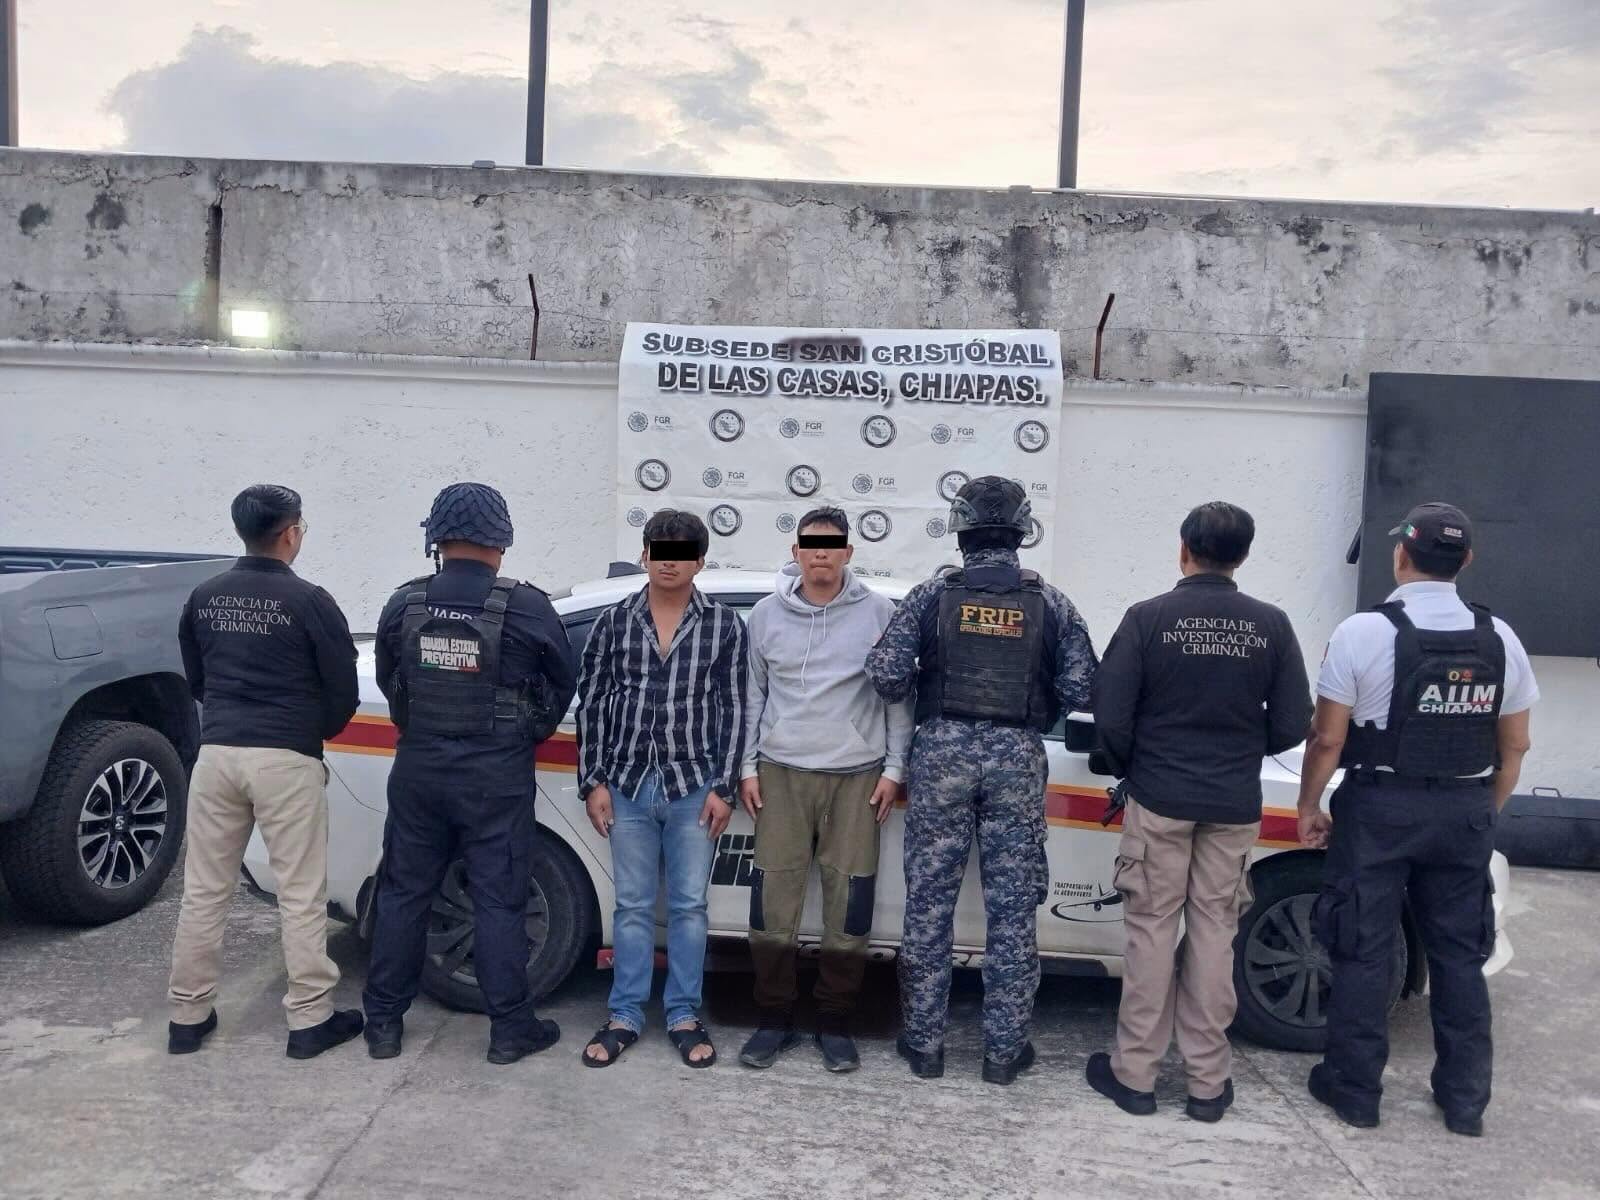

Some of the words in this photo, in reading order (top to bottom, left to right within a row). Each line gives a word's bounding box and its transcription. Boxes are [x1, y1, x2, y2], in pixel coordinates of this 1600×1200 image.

[642, 332, 789, 361] SUBSEDE
[798, 342, 864, 362] SAN
[871, 338, 1051, 364] CRISTÓBAL
[658, 361, 699, 390] DE
[707, 364, 768, 393] LAS
[777, 367, 889, 403] CASAS,
[899, 371, 1045, 402] CHIAPAS.
[654, 415, 671, 424] FGR
[805, 422, 822, 431] FGR
[957, 427, 975, 436] FGR
[728, 471, 745, 480] FGR
[878, 477, 895, 486] FGR
[1031, 483, 1048, 491] FGR
[208, 595, 262, 609] AGENCIA
[264, 599, 282, 612] DE
[960, 605, 1024, 626] FRIP
[211, 620, 272, 635] CRIMINAL
[1175, 617, 1237, 631] AGENCIA
[1239, 620, 1256, 633] DE
[1162, 631, 1268, 649] INVESTIGACIÓN
[1182, 644, 1250, 658] CRIMINAL
[421, 650, 478, 668] PREVENTIVA
[1419, 684, 1497, 702] AIIM
[1418, 703, 1493, 714] CHIAPAS
